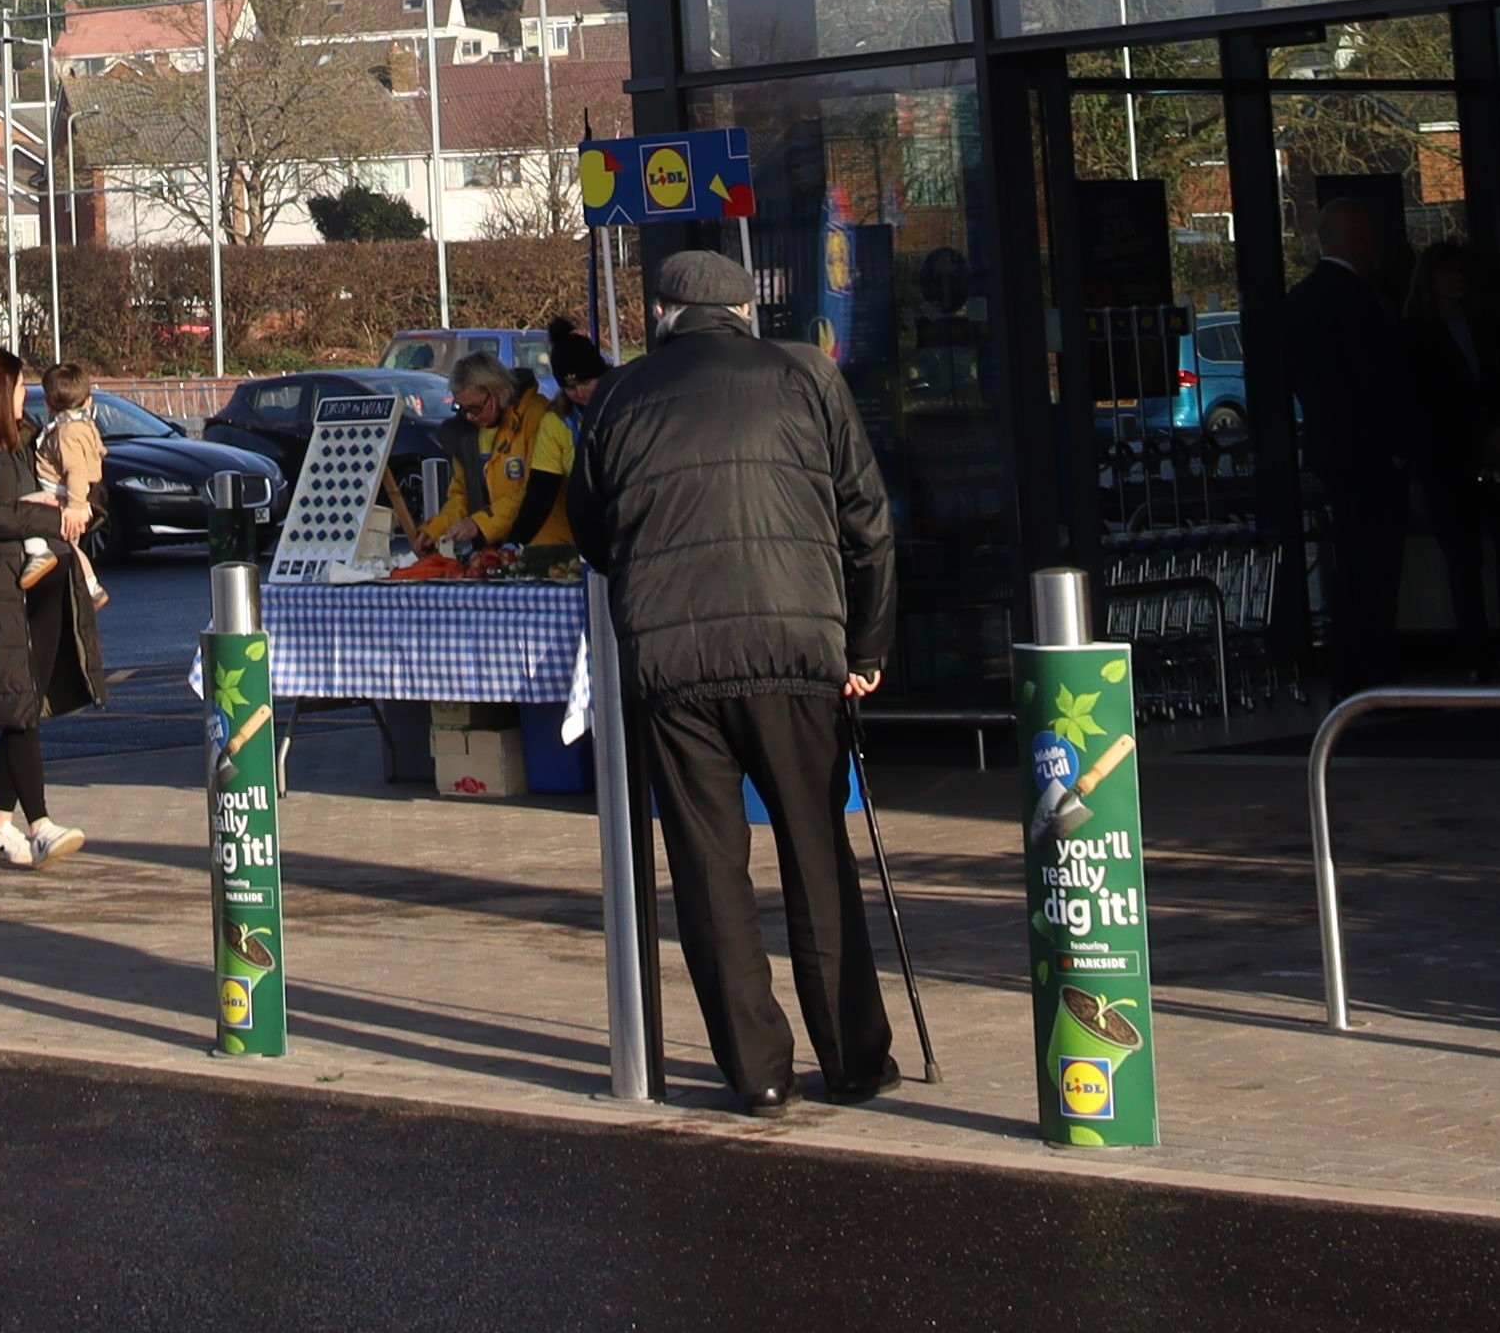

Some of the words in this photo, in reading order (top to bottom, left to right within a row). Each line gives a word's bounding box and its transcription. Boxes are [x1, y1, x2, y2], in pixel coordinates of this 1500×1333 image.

[1042, 757, 1071, 779] Lidl
[242, 833, 273, 866] it!
[1056, 831, 1132, 866] you'll
[1042, 860, 1106, 893] really
[1044, 887, 1092, 937] dig
[1099, 887, 1139, 926] it!
[1070, 941, 1110, 953] featuring
